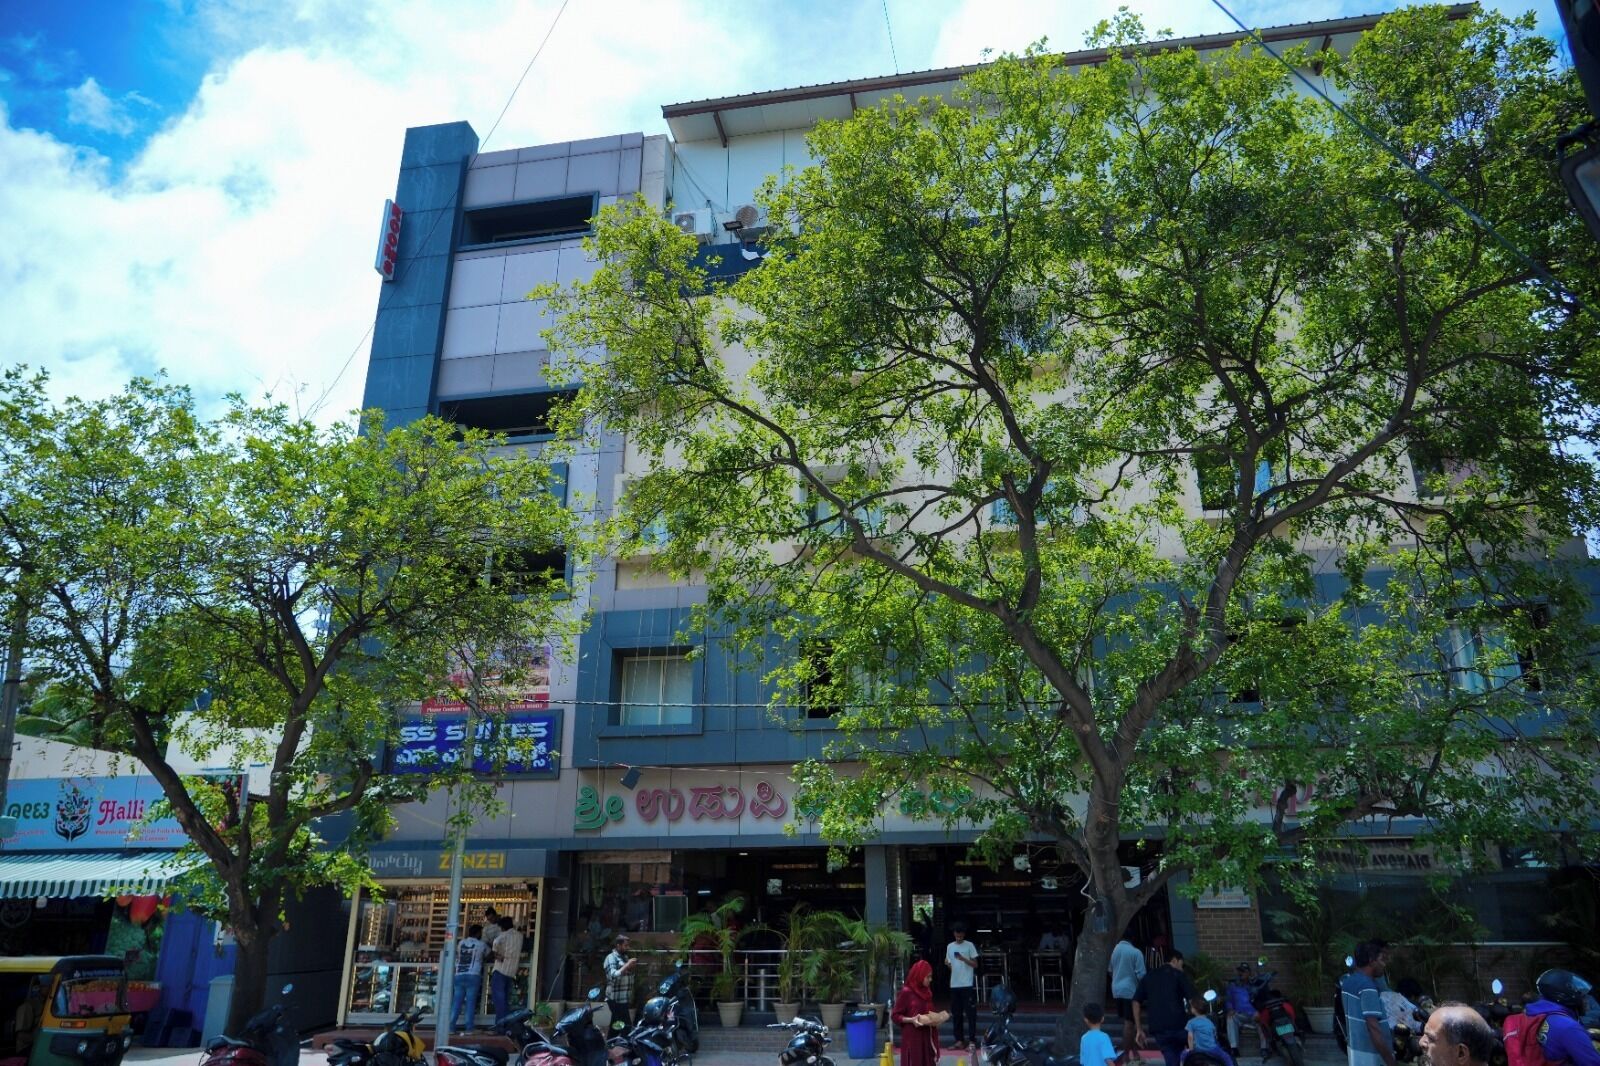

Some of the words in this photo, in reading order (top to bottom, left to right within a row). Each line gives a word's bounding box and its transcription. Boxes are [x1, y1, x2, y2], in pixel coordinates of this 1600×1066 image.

[400, 725, 437, 742] SS
[97, 799, 145, 826] Halli
[574, 784, 625, 831] ಶ್ರೀ
[635, 780, 788, 822] ಉಡುಪಿ
[439, 852, 505, 870] ZNZEI
